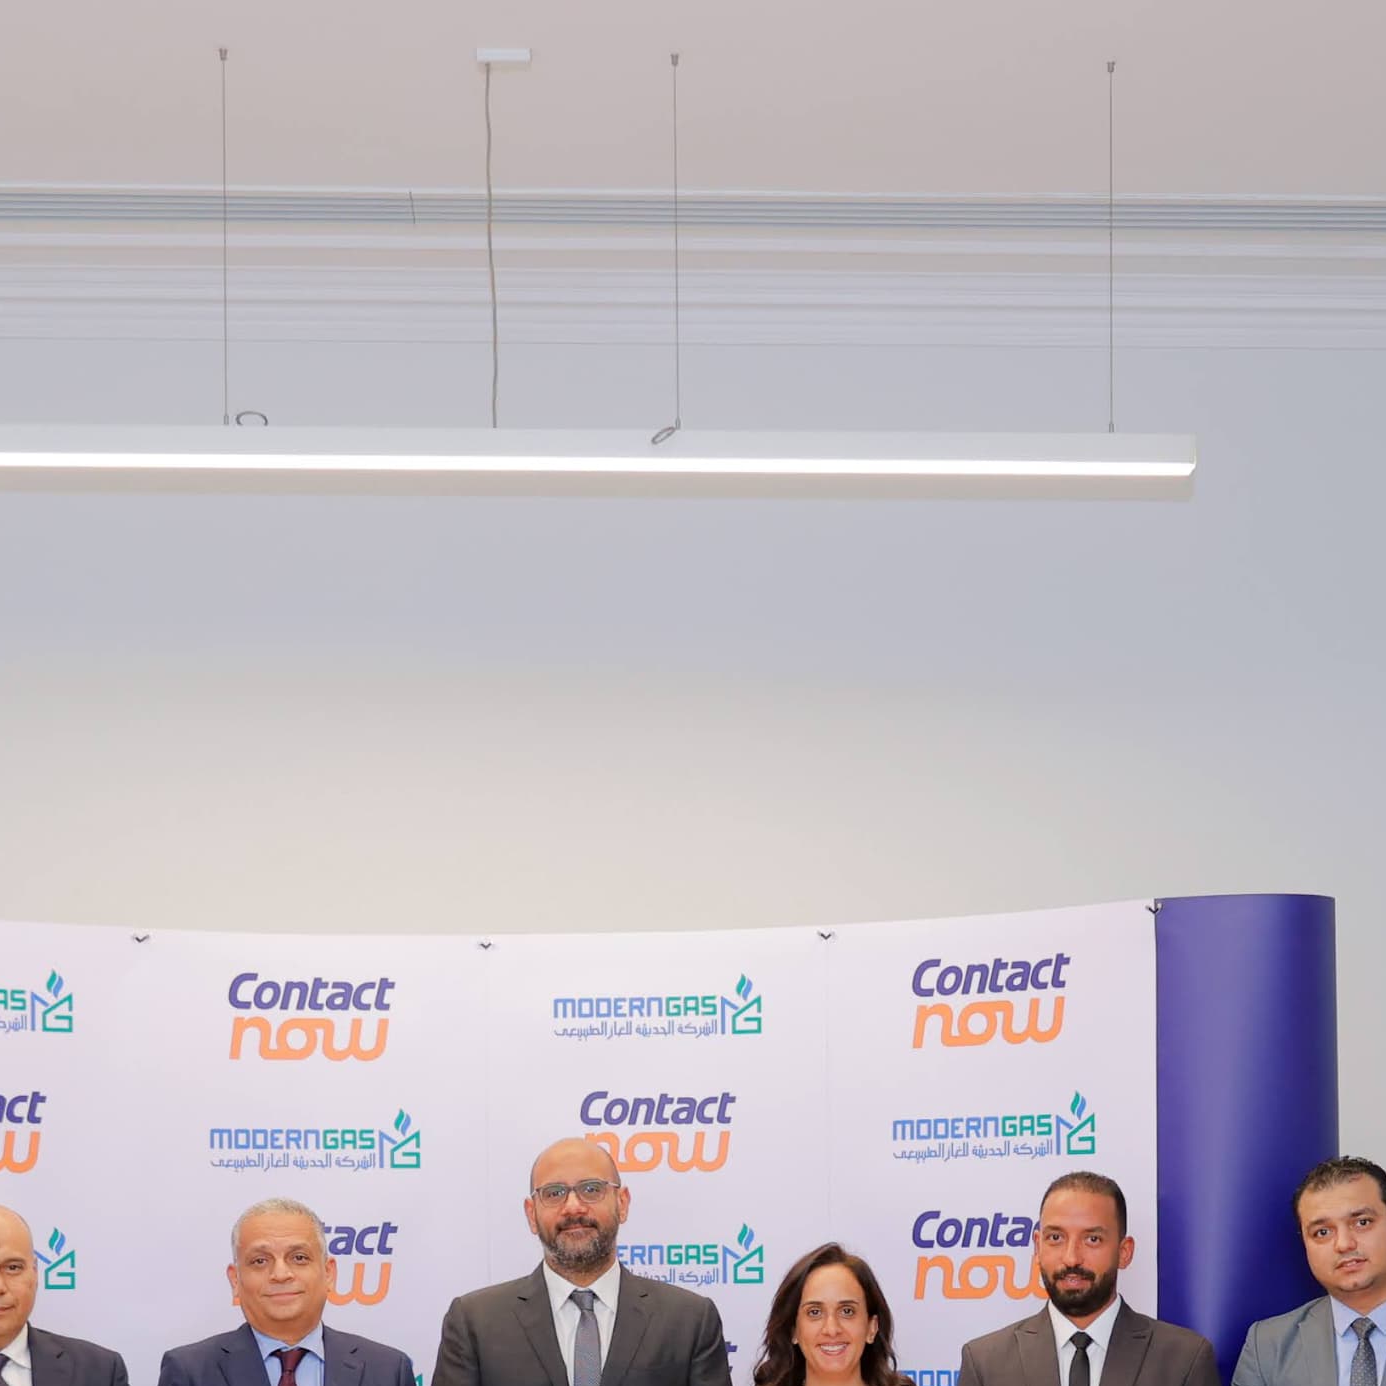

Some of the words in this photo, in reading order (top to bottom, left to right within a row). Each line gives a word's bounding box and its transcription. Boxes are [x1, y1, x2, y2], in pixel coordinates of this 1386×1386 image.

[228, 972, 396, 1011] Contact
[912, 953, 1071, 997] Contact
[229, 1016, 390, 1062] now
[912, 996, 1066, 1049] now
[580, 1091, 737, 1126] Contact
[912, 1211, 1039, 1248] Conta
[616, 1244, 719, 1265] ERNGAS
